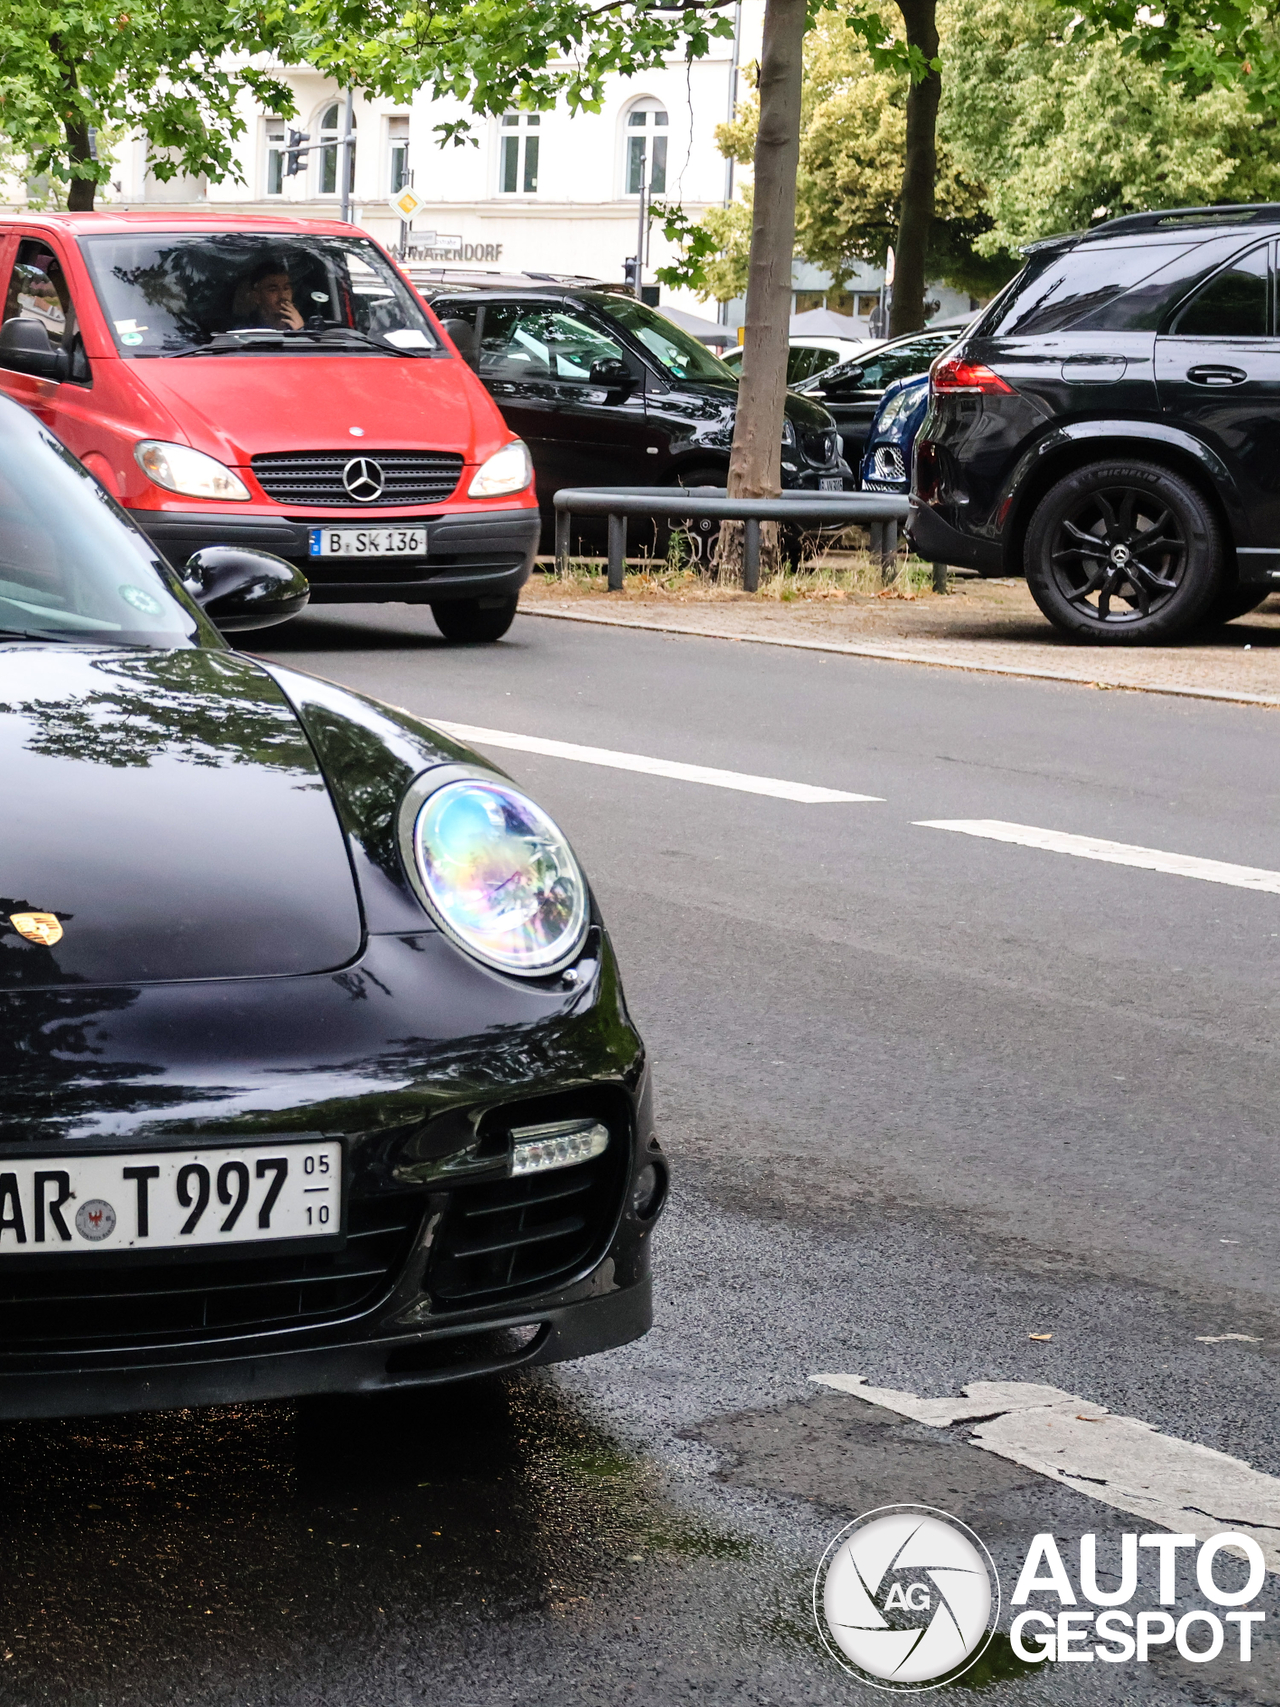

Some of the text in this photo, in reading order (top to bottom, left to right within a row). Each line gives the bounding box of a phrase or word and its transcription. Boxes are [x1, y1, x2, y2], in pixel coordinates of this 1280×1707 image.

[330, 534, 342, 552] B
[385, 532, 418, 552] 136
[304, 1154, 330, 1174] 05
[123, 1165, 160, 1237] T
[176, 1157, 289, 1235] 997
[305, 1206, 330, 1225] 10
